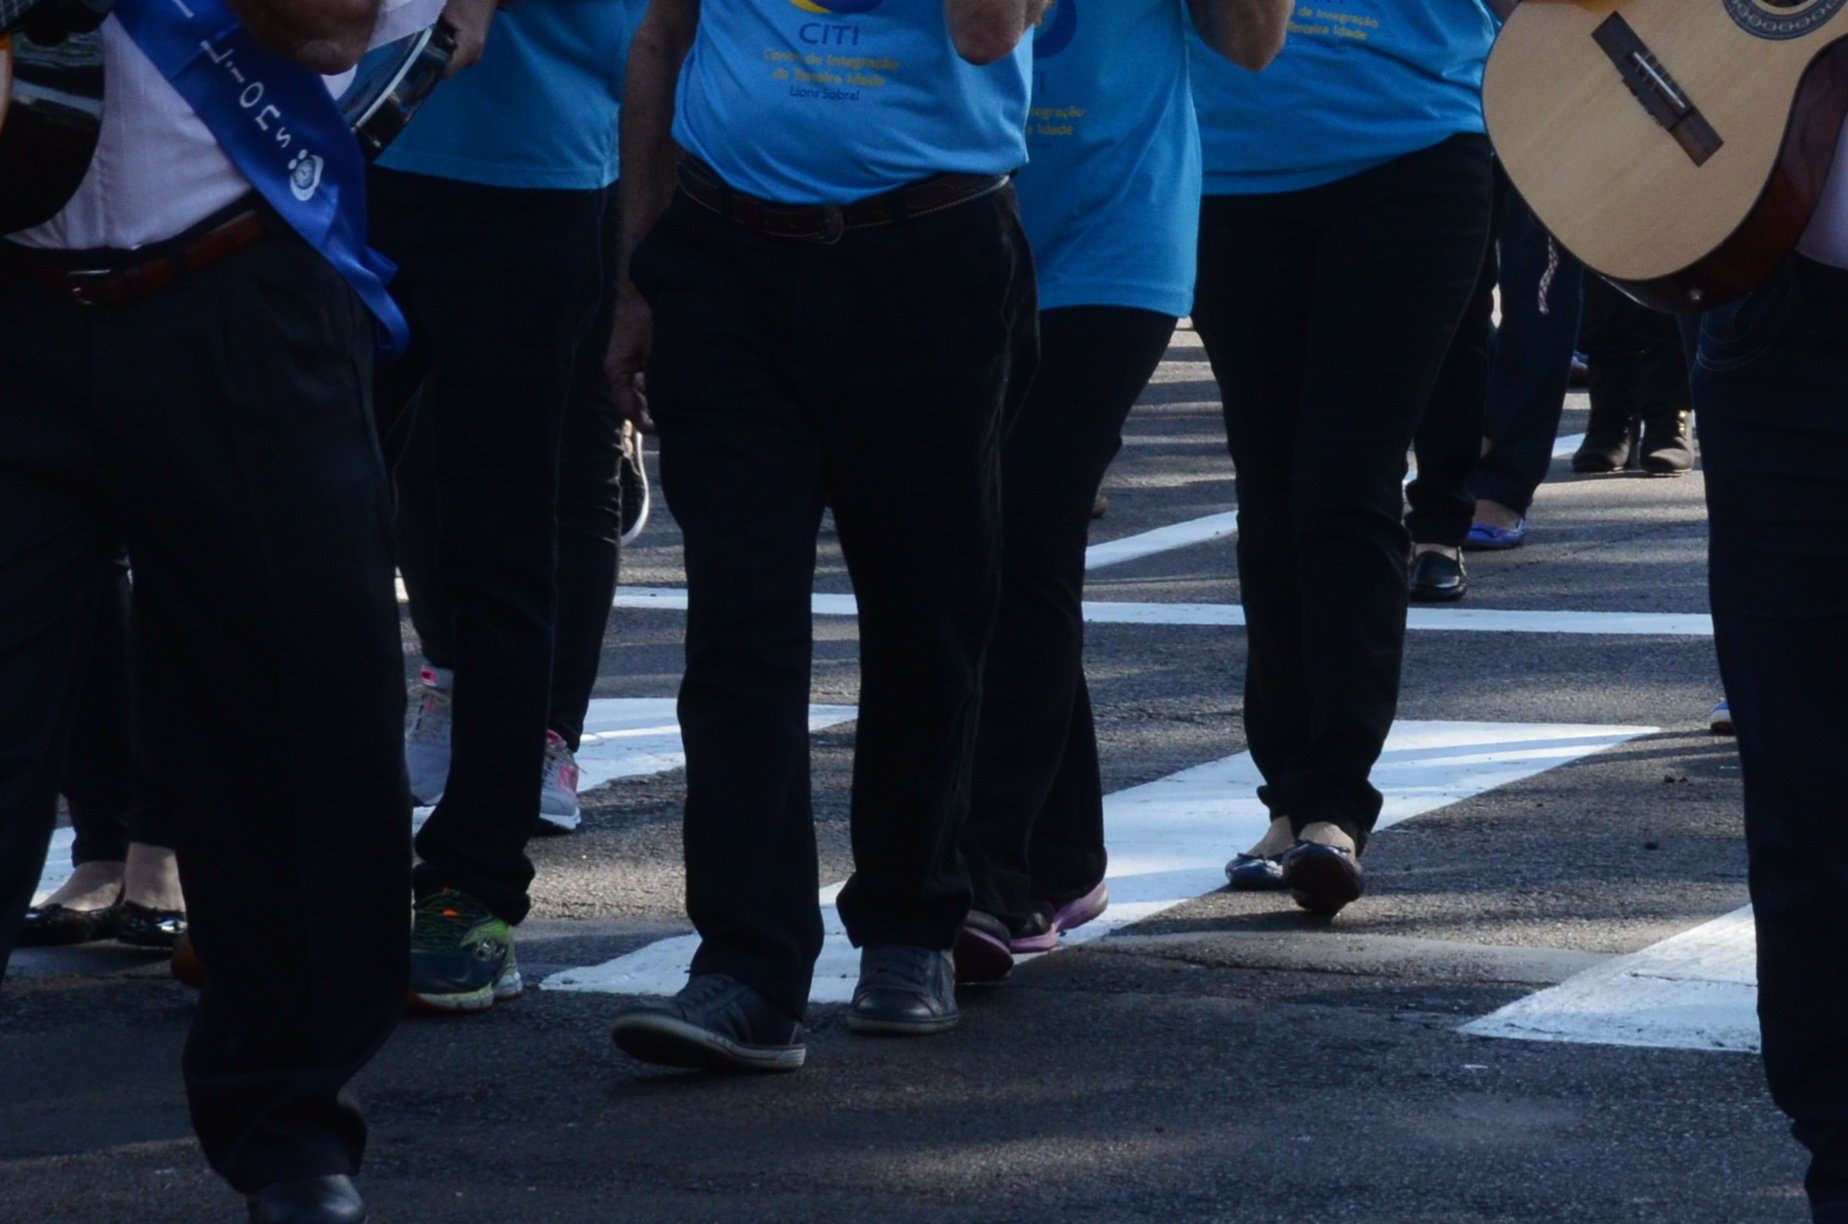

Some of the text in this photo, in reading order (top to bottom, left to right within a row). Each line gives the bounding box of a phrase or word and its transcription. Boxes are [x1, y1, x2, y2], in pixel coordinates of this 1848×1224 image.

[799, 23, 860, 45] CITI
[826, 54, 899, 71] Integração
[822, 87, 860, 101] Sobral
